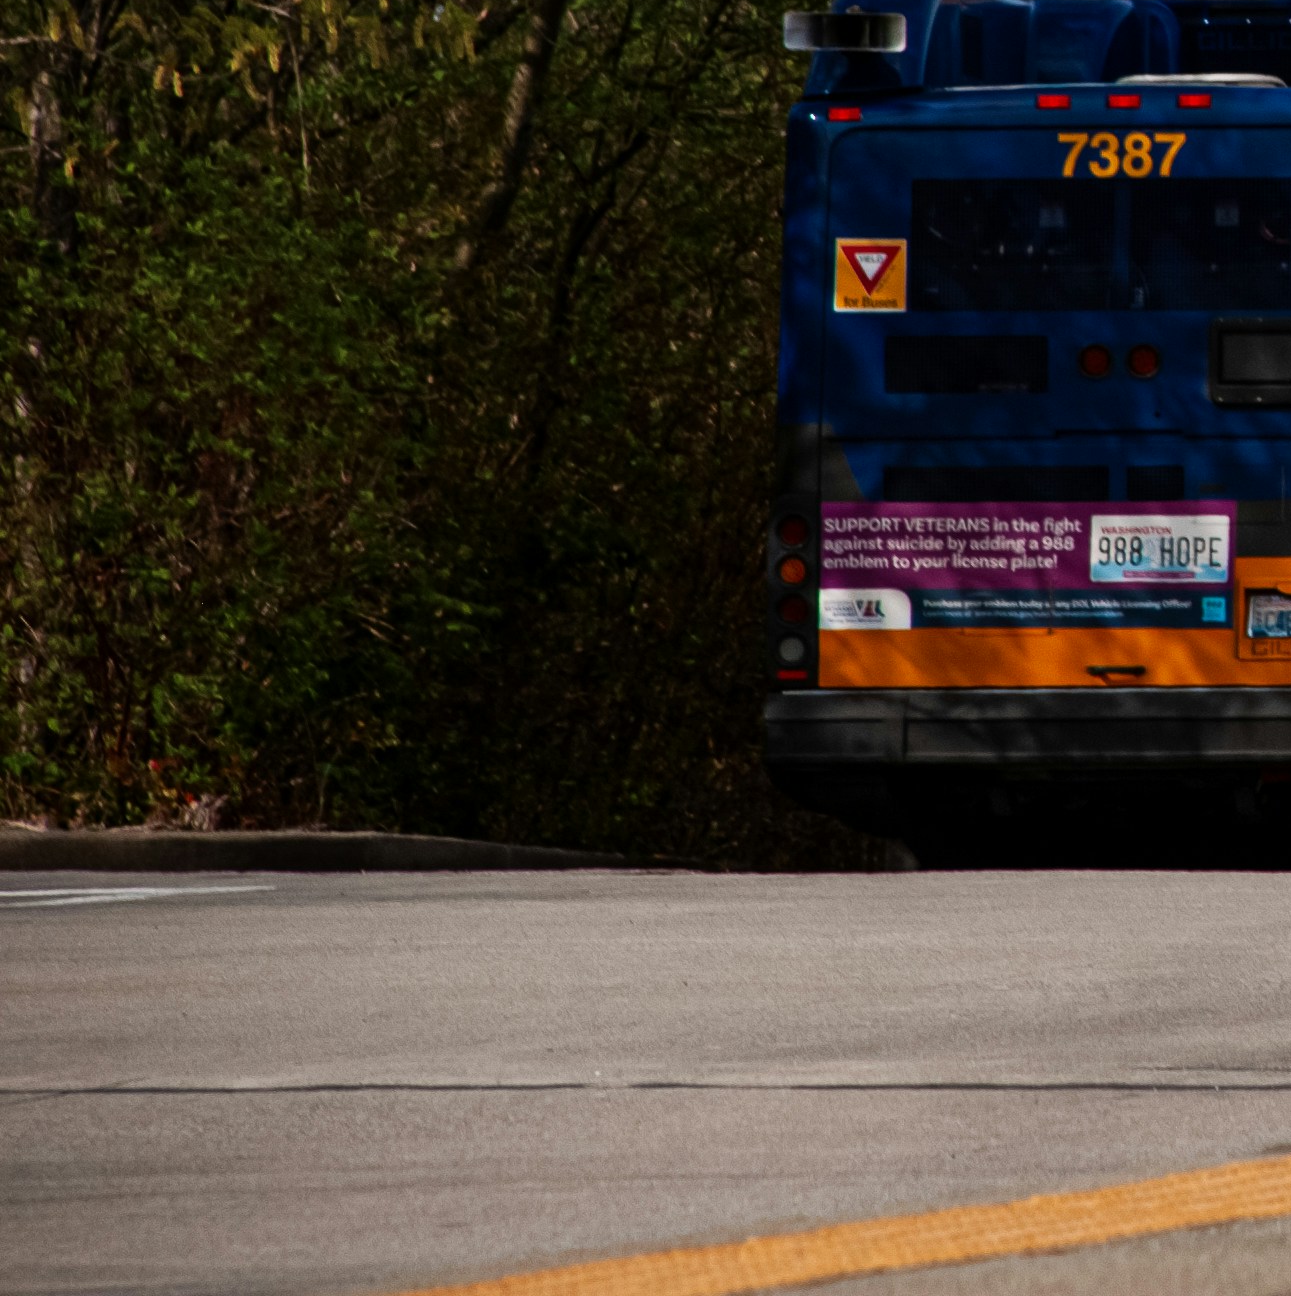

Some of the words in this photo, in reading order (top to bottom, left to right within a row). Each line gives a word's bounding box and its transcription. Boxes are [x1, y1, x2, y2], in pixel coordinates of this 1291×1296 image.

[1057, 131, 1187, 179] 7387
[823, 516, 902, 533] SUPPORT
[904, 516, 990, 533] VETERANS
[993, 516, 1009, 533] in
[1013, 516, 1041, 533] the
[1043, 515, 1082, 537] fight
[1101, 526, 1172, 535] WASHINGTON
[823, 535, 884, 555] against
[886, 535, 944, 551] suicide
[947, 535, 967, 555] by
[969, 535, 1026, 555] adding
[1028, 538, 1039, 551] a
[1041, 535, 1075, 551] 988
[1099, 536, 1143, 566] 988
[1160, 536, 1223, 567] HOPE
[823, 554, 890, 569] emblem
[892, 555, 910, 569] to
[912, 557, 949, 572] your
[951, 553, 1007, 569] license
[1009, 553, 1059, 572] plate!
